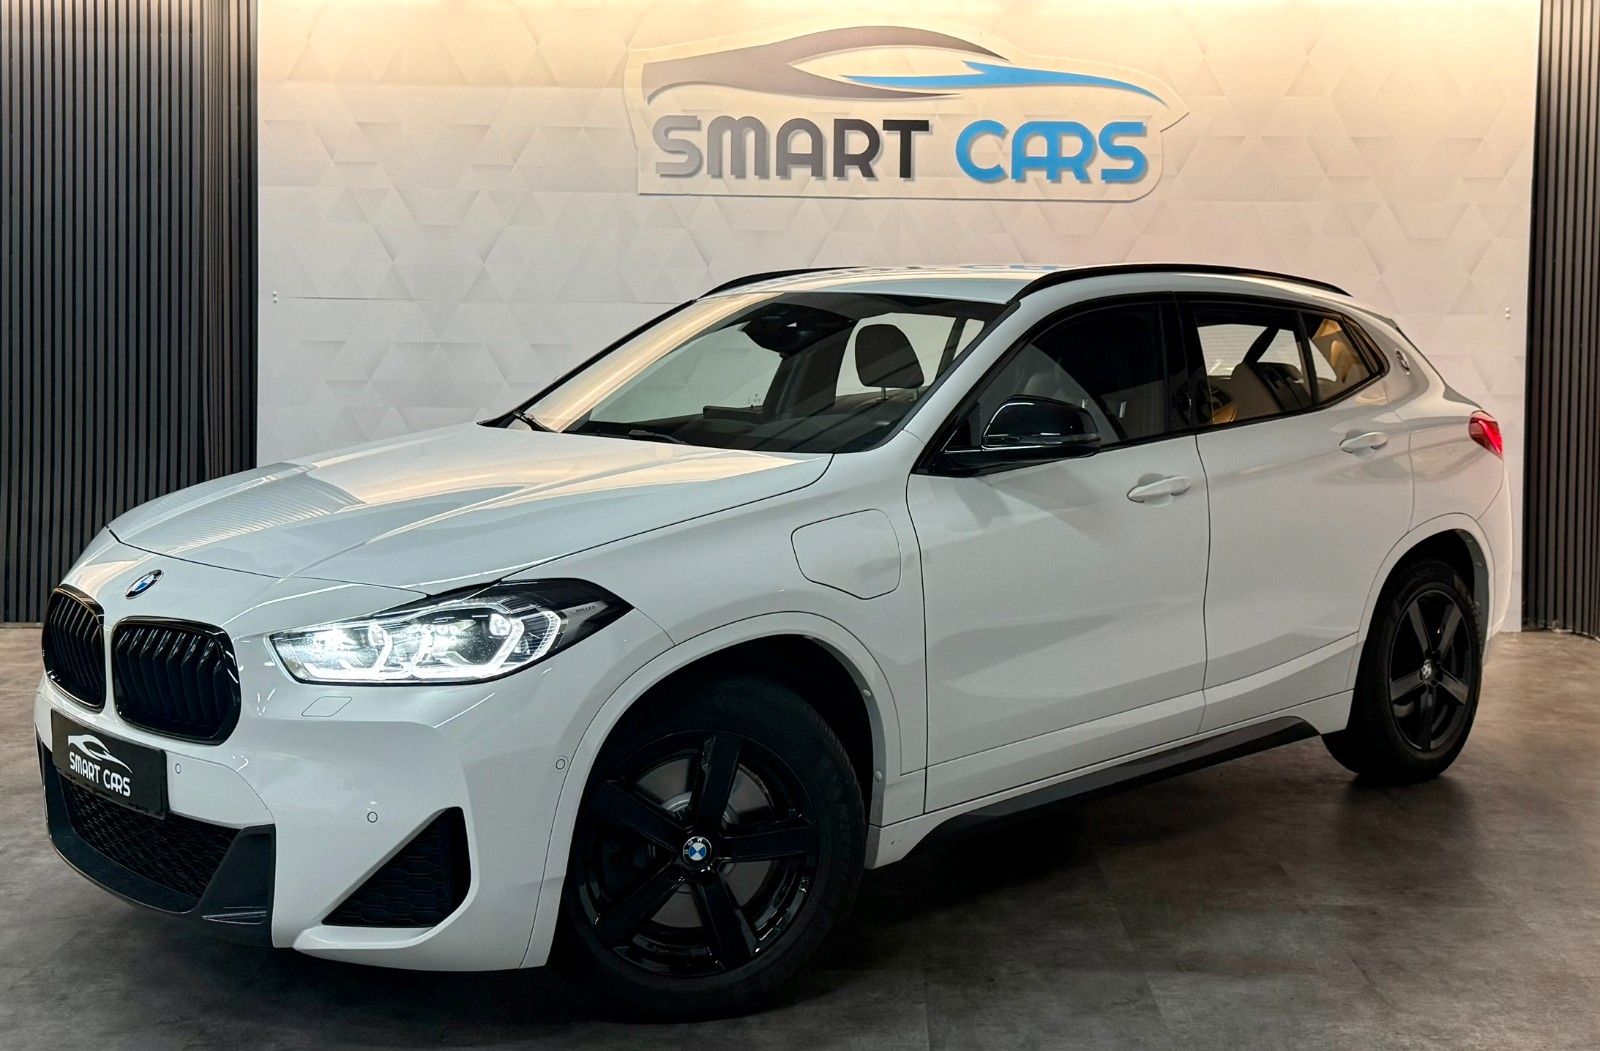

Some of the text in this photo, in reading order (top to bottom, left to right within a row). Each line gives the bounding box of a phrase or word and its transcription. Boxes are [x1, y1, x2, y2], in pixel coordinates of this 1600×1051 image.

[653, 115, 1148, 183] SMART CARS
[69, 751, 131, 797] SMART CARS
